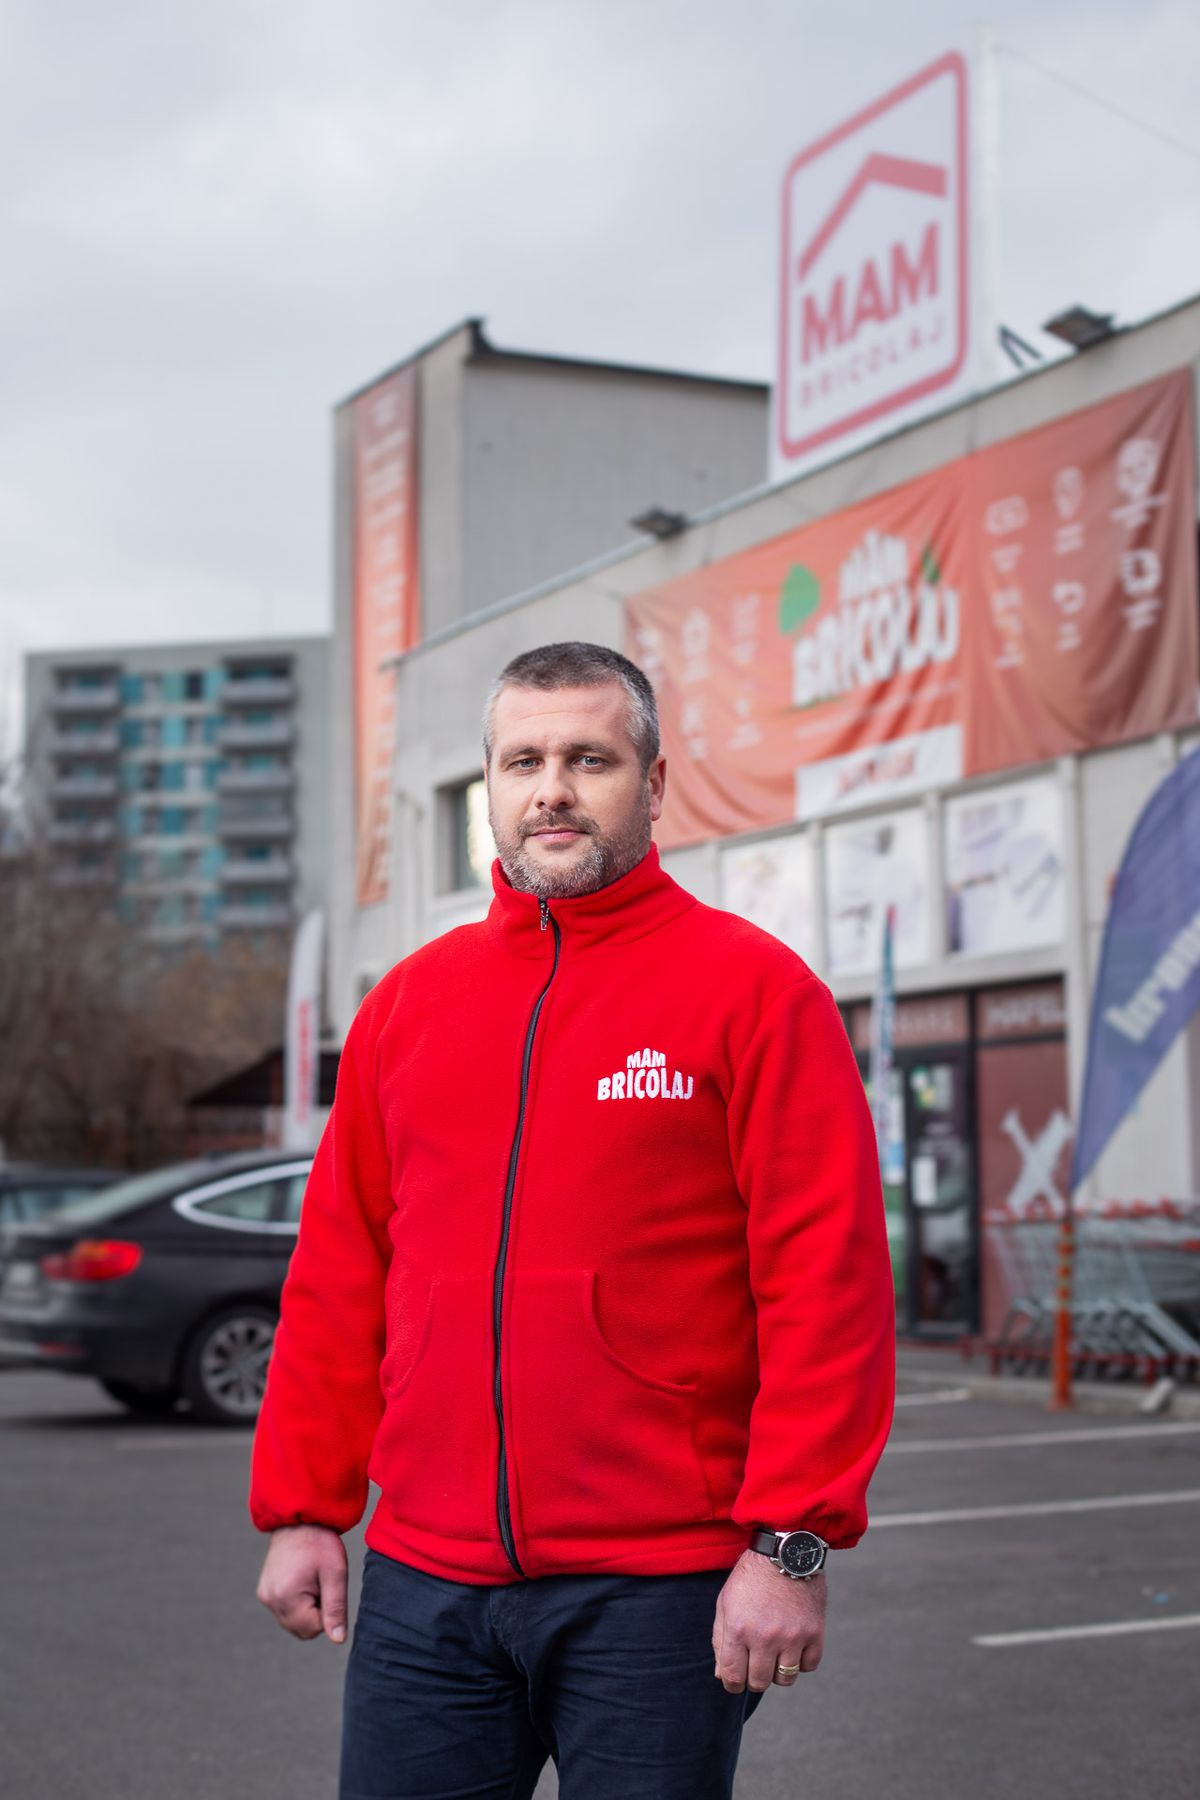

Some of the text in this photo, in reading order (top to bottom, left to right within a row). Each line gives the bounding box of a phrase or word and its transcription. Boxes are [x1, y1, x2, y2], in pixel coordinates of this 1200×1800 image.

[802, 221, 939, 366] MAM
[627, 1048, 666, 1068] MAM
[597, 1067, 694, 1100] BRICOLAJ
